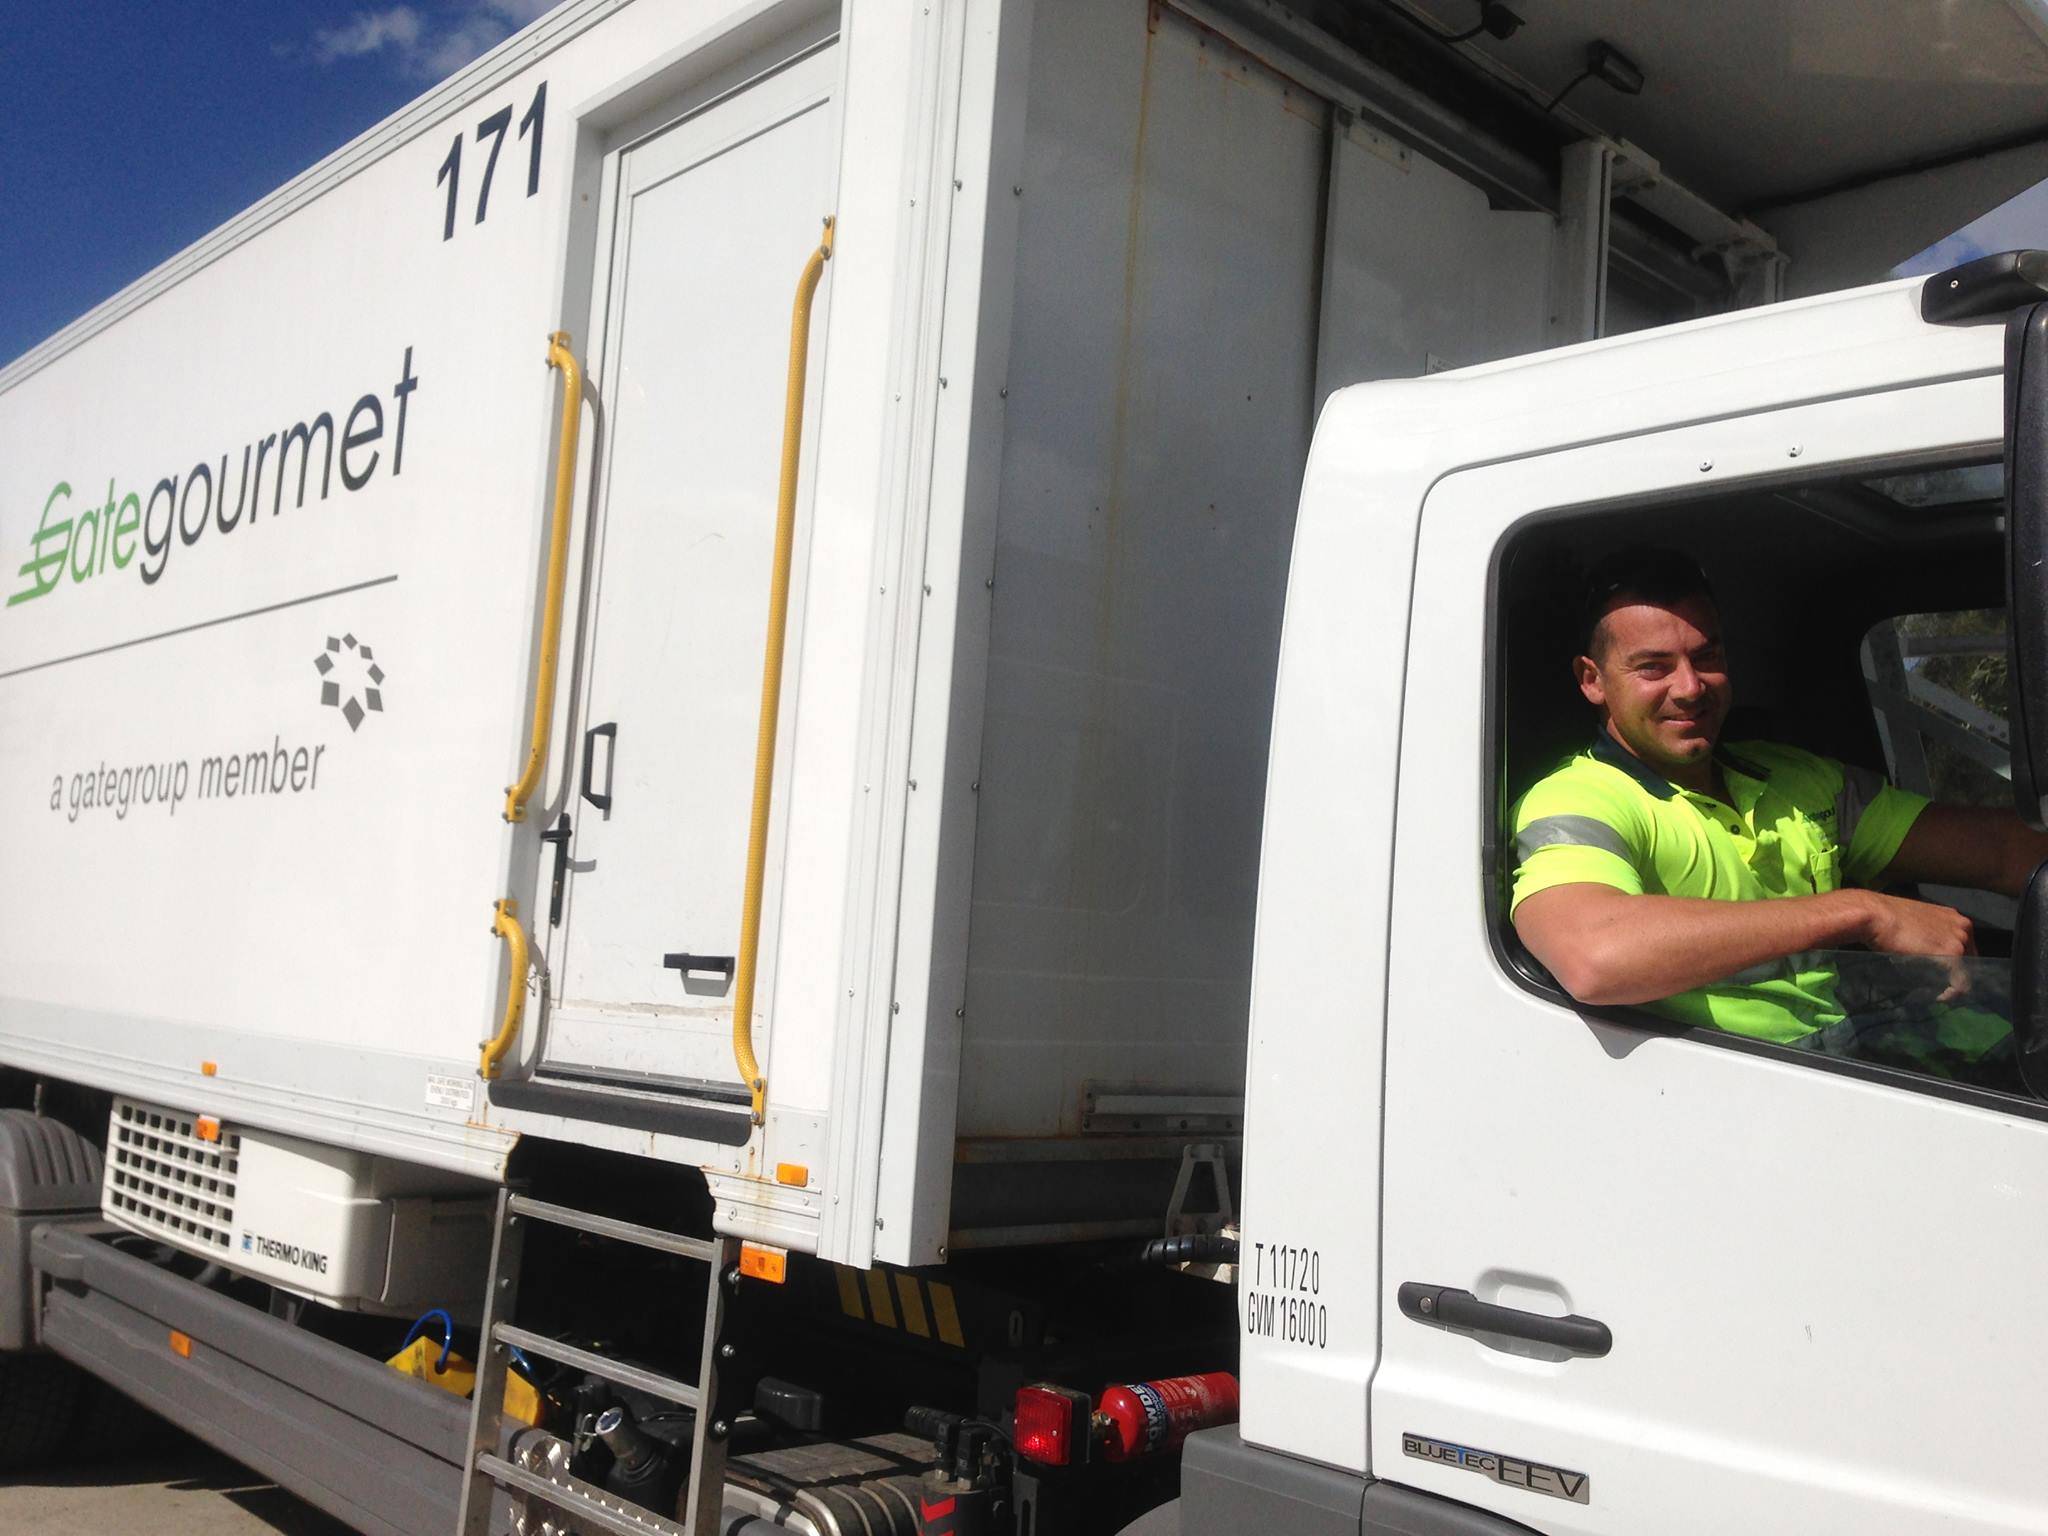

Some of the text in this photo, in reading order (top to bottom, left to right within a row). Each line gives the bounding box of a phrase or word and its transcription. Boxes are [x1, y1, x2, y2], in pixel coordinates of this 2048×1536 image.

[436, 80, 548, 242] 171
[7, 345, 419, 608] Gategourmet
[50, 735, 325, 822] a gategroup member
[256, 1235, 300, 1266] THERMO
[301, 1249, 328, 1275] KING
[1255, 1242, 1320, 1295] T 11720
[1247, 1291, 1327, 1350] GVM 16000
[1404, 1439, 1586, 1498] BLUETEC EEV
